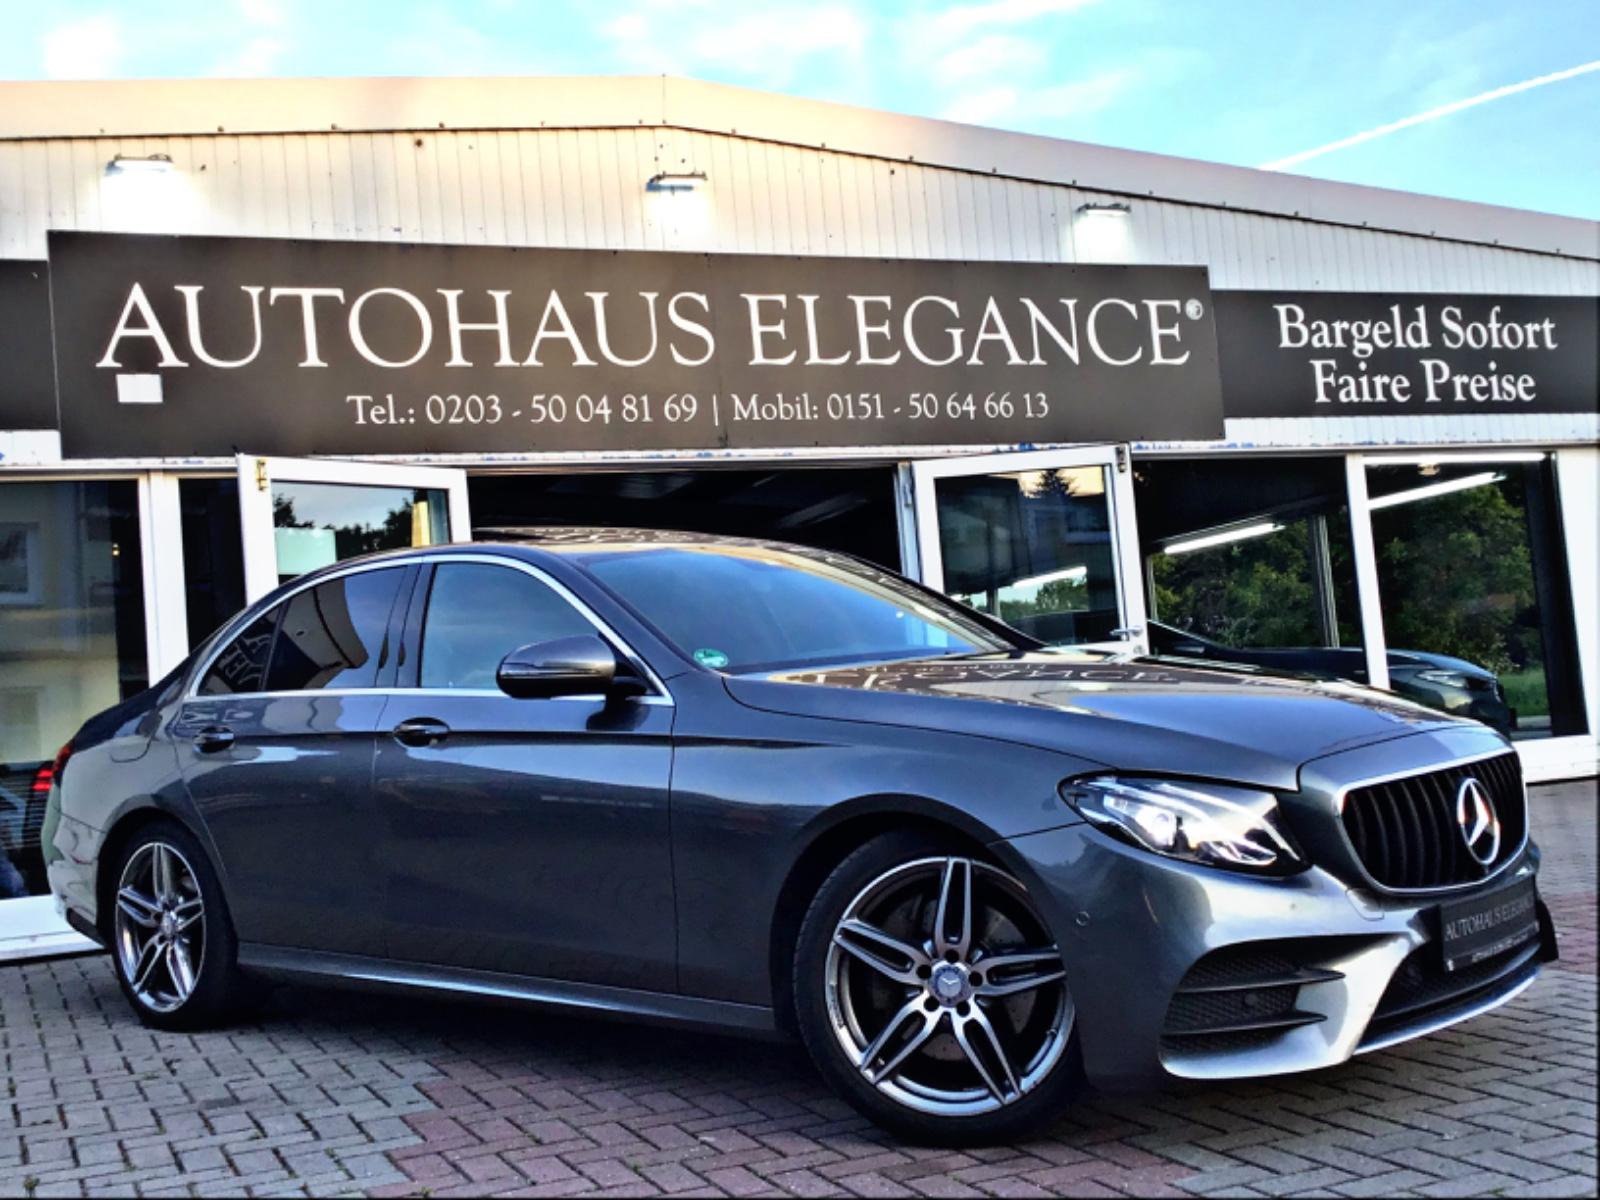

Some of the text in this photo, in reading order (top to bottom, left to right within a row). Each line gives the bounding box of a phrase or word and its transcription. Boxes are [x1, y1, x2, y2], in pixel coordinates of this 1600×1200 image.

[96, 282, 1192, 369] AUTOHAUS ELEGANCE
[1272, 303, 1558, 359] Bargeld Sofort
[1308, 358, 1536, 403] Faire Preise
[345, 393, 416, 425] Tel.:
[426, 394, 503, 425] 0203
[530, 393, 568, 424] 50
[575, 393, 613, 425] 04
[621, 393, 653, 423] 81
[663, 393, 698, 424] 69
[730, 391, 819, 421] Mobil:
[826, 392, 885, 421] 0151
[908, 391, 939, 420] 50
[946, 391, 977, 420] 64
[983, 391, 1015, 420] 66
[1023, 391, 1049, 419] 13
[1501, 896, 1534, 920] ELEG
